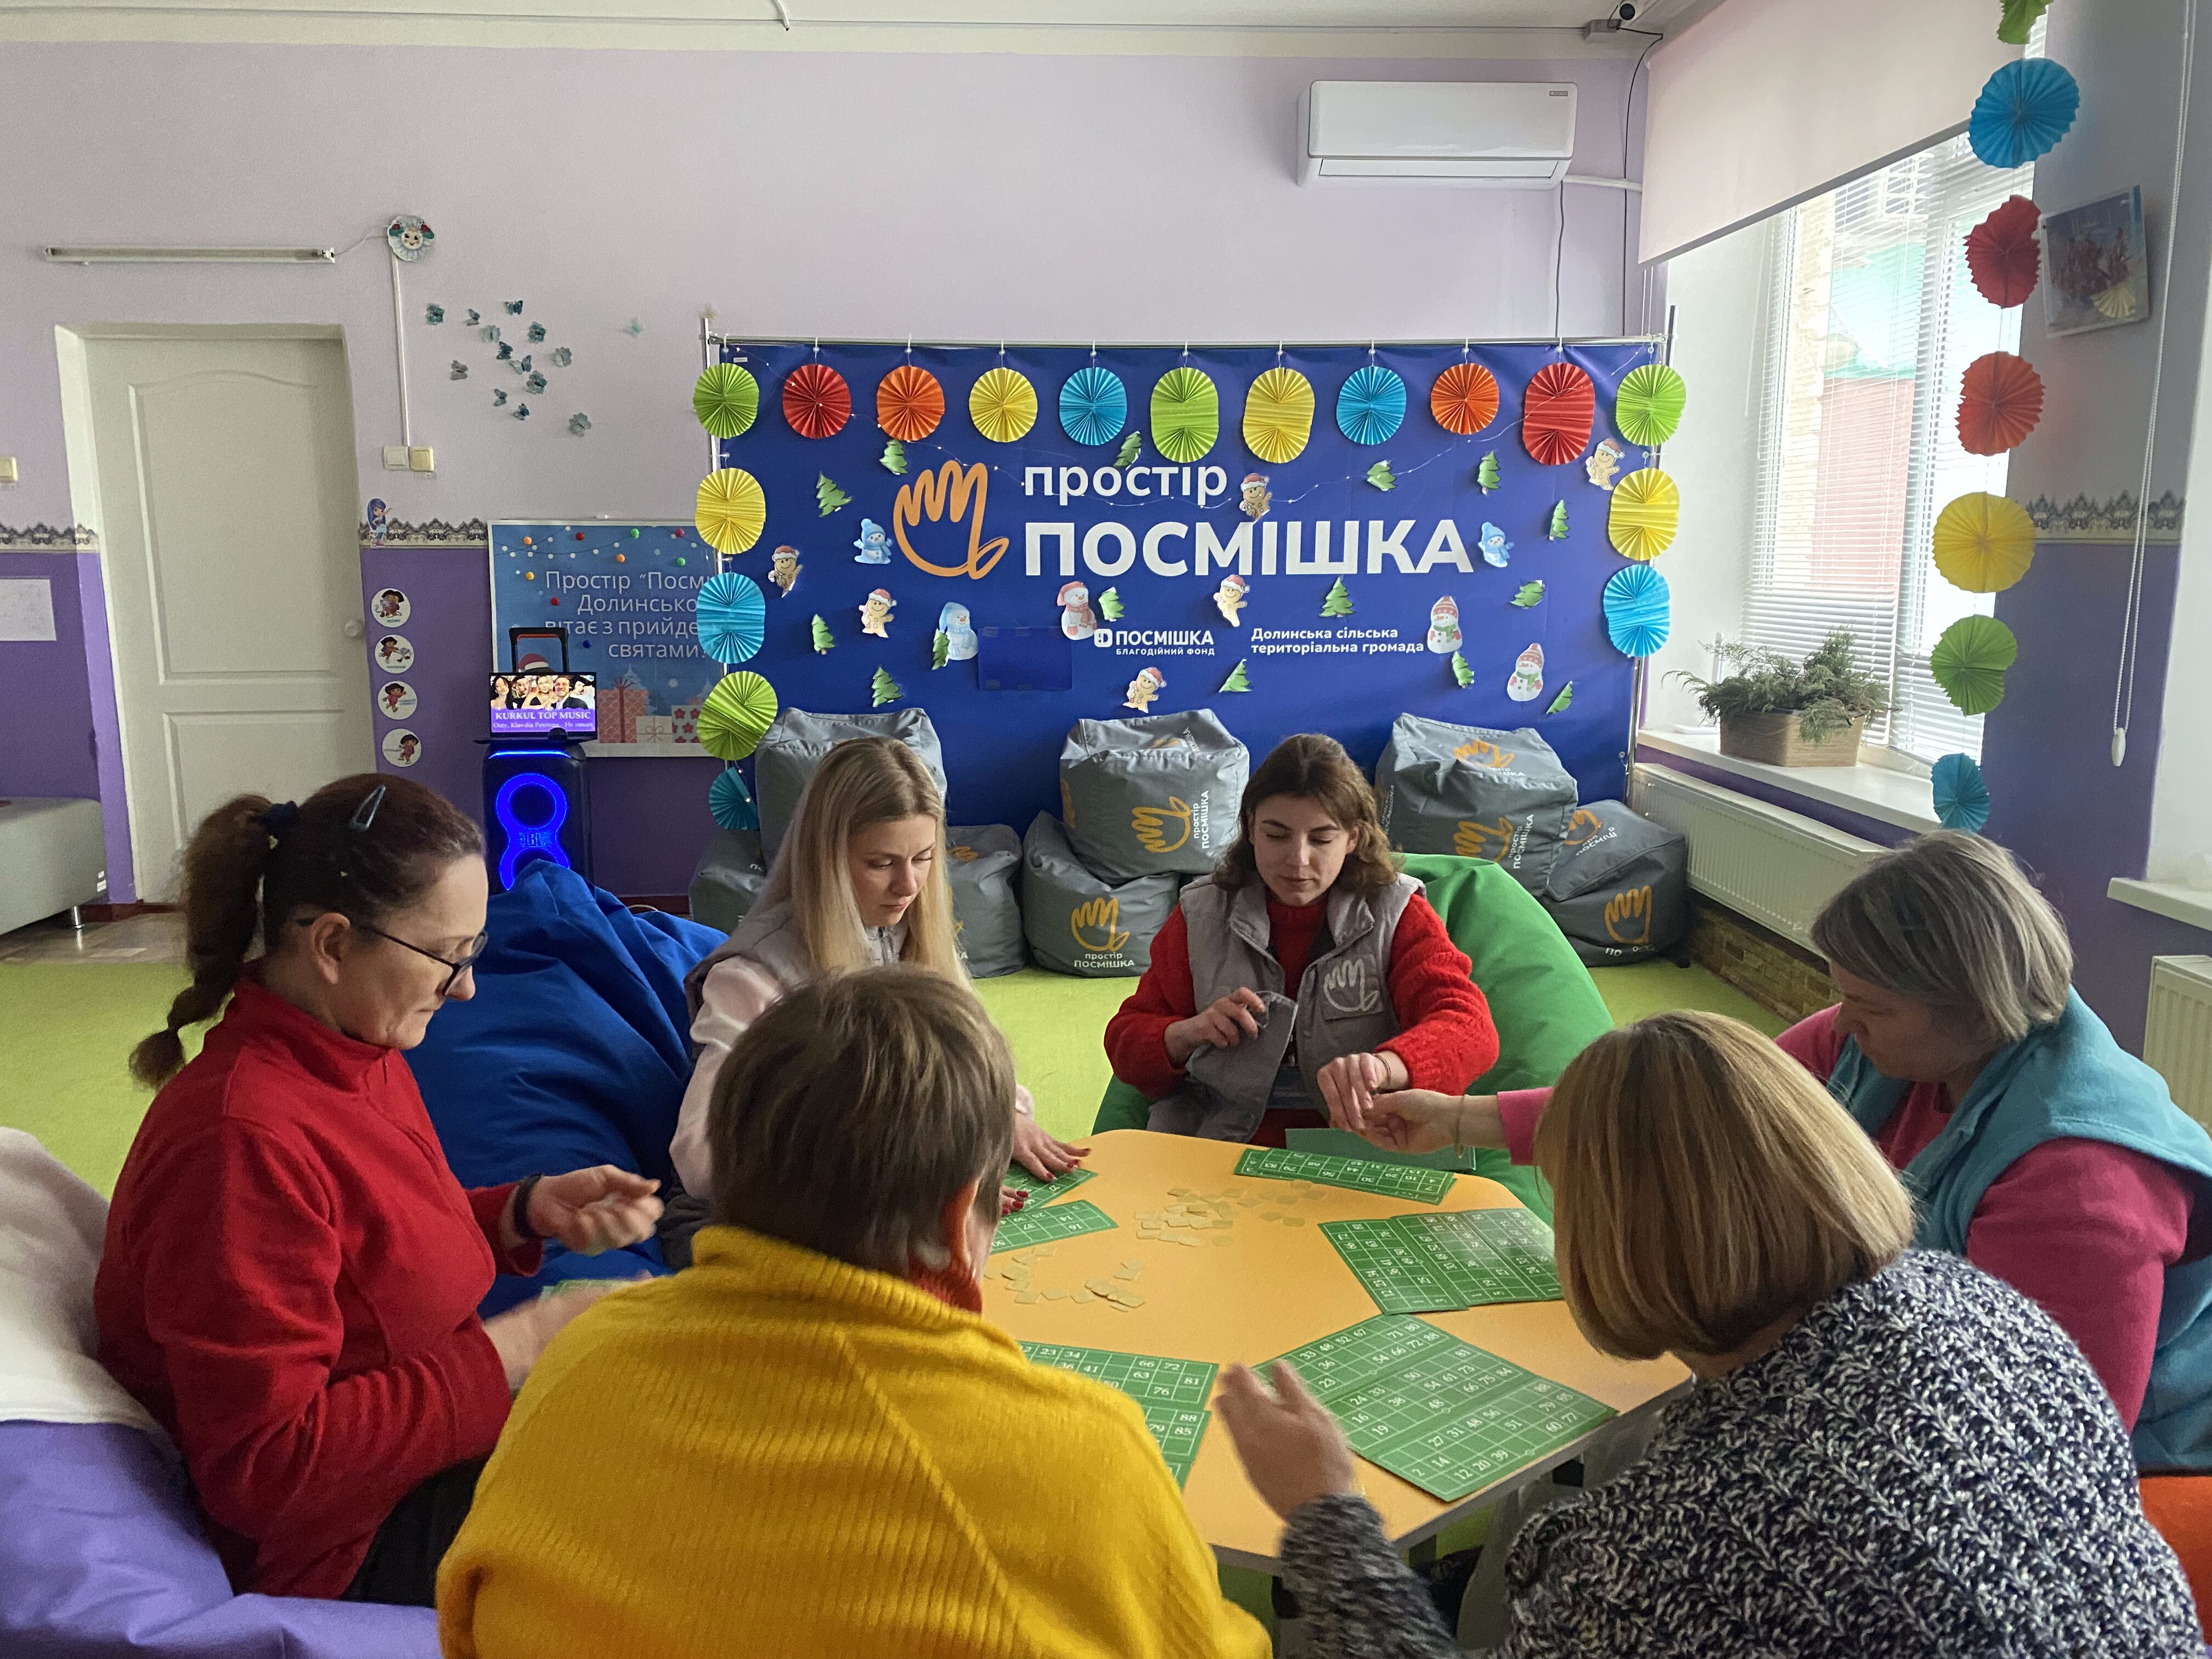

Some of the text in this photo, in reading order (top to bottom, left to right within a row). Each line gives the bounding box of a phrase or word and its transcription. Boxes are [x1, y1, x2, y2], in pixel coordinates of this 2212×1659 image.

[1024, 466, 1227, 506] простір
[1025, 519, 1475, 576] ПОСМІШКА
[546, 571, 710, 594] Простір “Посм
[577, 594, 697, 615] Долинсько
[1116, 630, 1214, 646] ПОСМІШКА
[1251, 627, 1398, 641] Долинська сільська
[1116, 647, 1215, 656] БЛАГОДІЙНИЙ ФОНД
[1251, 641, 1424, 654] територіальна громада
[1191, 803, 1200, 839] простір
[1201, 791, 1210, 849] ПОСМІШКА
[1508, 826, 1523, 858] простір
[1513, 814, 1534, 869] ПОСМІШКА
[1074, 960, 1135, 968] ПОСМІШКА
[1085, 951, 1123, 961] простір
[1299, 1350, 1316, 1360] 33
[1319, 1343, 1334, 1351] 48
[1353, 1328, 1367, 1337] 67
[1318, 1360, 1335, 1369] 36
[1386, 1330, 1404, 1339] 71
[1318, 1378, 1336, 1388] 23
[1372, 1354, 1390, 1363] 54
[1391, 1346, 1406, 1356] 66
[1406, 1339, 1424, 1348] 72
[1153, 1386, 1170, 1396] 76
[1184, 1377, 1199, 1385] 81
[1350, 1395, 1368, 1405] 24
[1368, 1387, 1385, 1396] 33
[1351, 1413, 1369, 1423] 16
[1423, 1380, 1442, 1390] 54
[1442, 1373, 1458, 1382] 61
[1457, 1365, 1475, 1374] 73
[1372, 1425, 1389, 1435] 19
[1428, 1399, 1444, 1409] 48
[1477, 1374, 1496, 1385] 75
[1180, 1414, 1197, 1422] 88
[1149, 1424, 1192, 1436] 79 85
[1411, 1468, 1425, 1476] 2
[1431, 1457, 1451, 1467] 14
[1504, 1419, 1522, 1430] 51
[1538, 1401, 1556, 1412] 79
[1427, 1435, 1444, 1447] 27
[1446, 1427, 1465, 1437] 31
[1454, 1469, 1473, 1480] 12
[1491, 1449, 1508, 1461] 39
[1545, 1421, 1563, 1432] 60
[1560, 1412, 1577, 1423] 77
